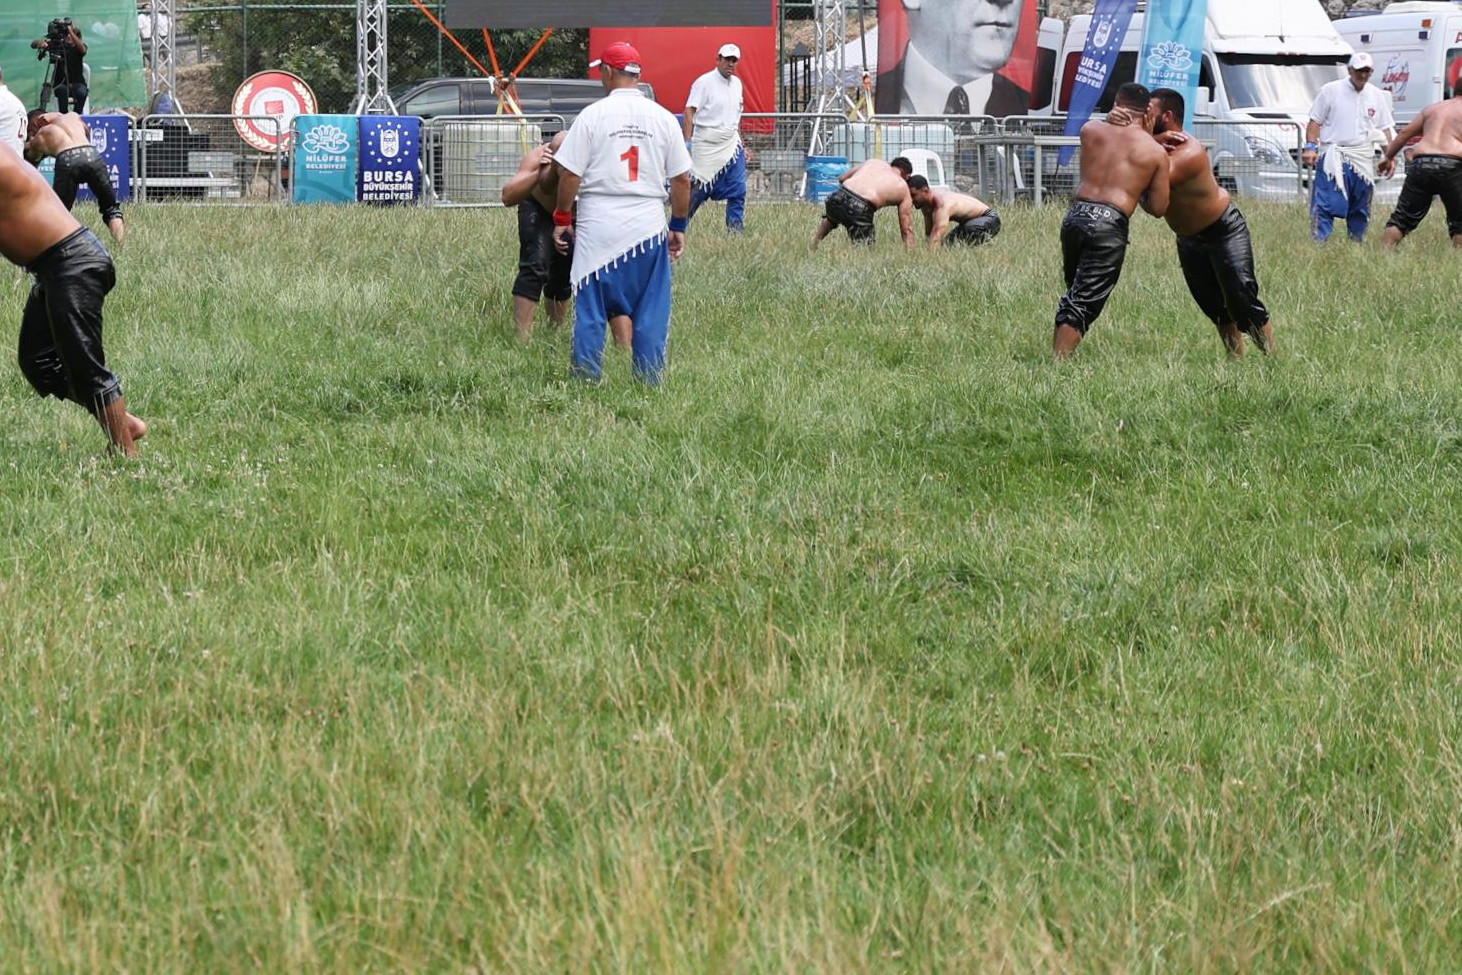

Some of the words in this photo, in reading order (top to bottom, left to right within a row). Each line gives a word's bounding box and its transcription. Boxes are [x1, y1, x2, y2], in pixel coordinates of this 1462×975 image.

[1081, 56, 1107, 74] URSA
[306, 153, 347, 162] NİLÜFER
[620, 145, 639, 182] 1
[363, 170, 414, 182] BURSA
[363, 190, 414, 201] BELEDİYESİ
